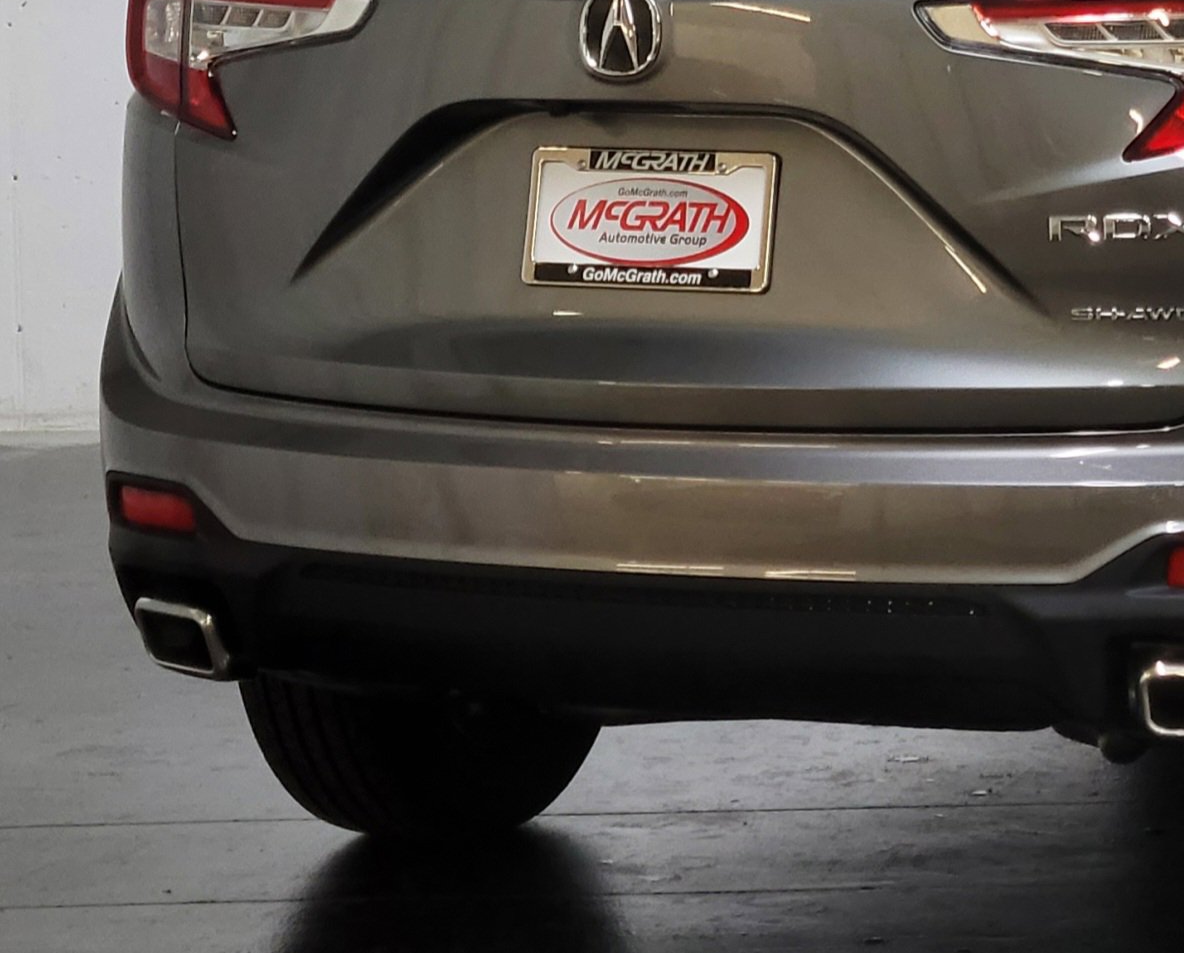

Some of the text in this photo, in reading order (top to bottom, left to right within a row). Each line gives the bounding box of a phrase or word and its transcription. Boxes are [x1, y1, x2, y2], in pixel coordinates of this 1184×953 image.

[617, 186, 688, 199] GoMcGrath.com
[599, 231, 708, 248] Automotive Group
[582, 265, 702, 286] GoMcGrath.com
